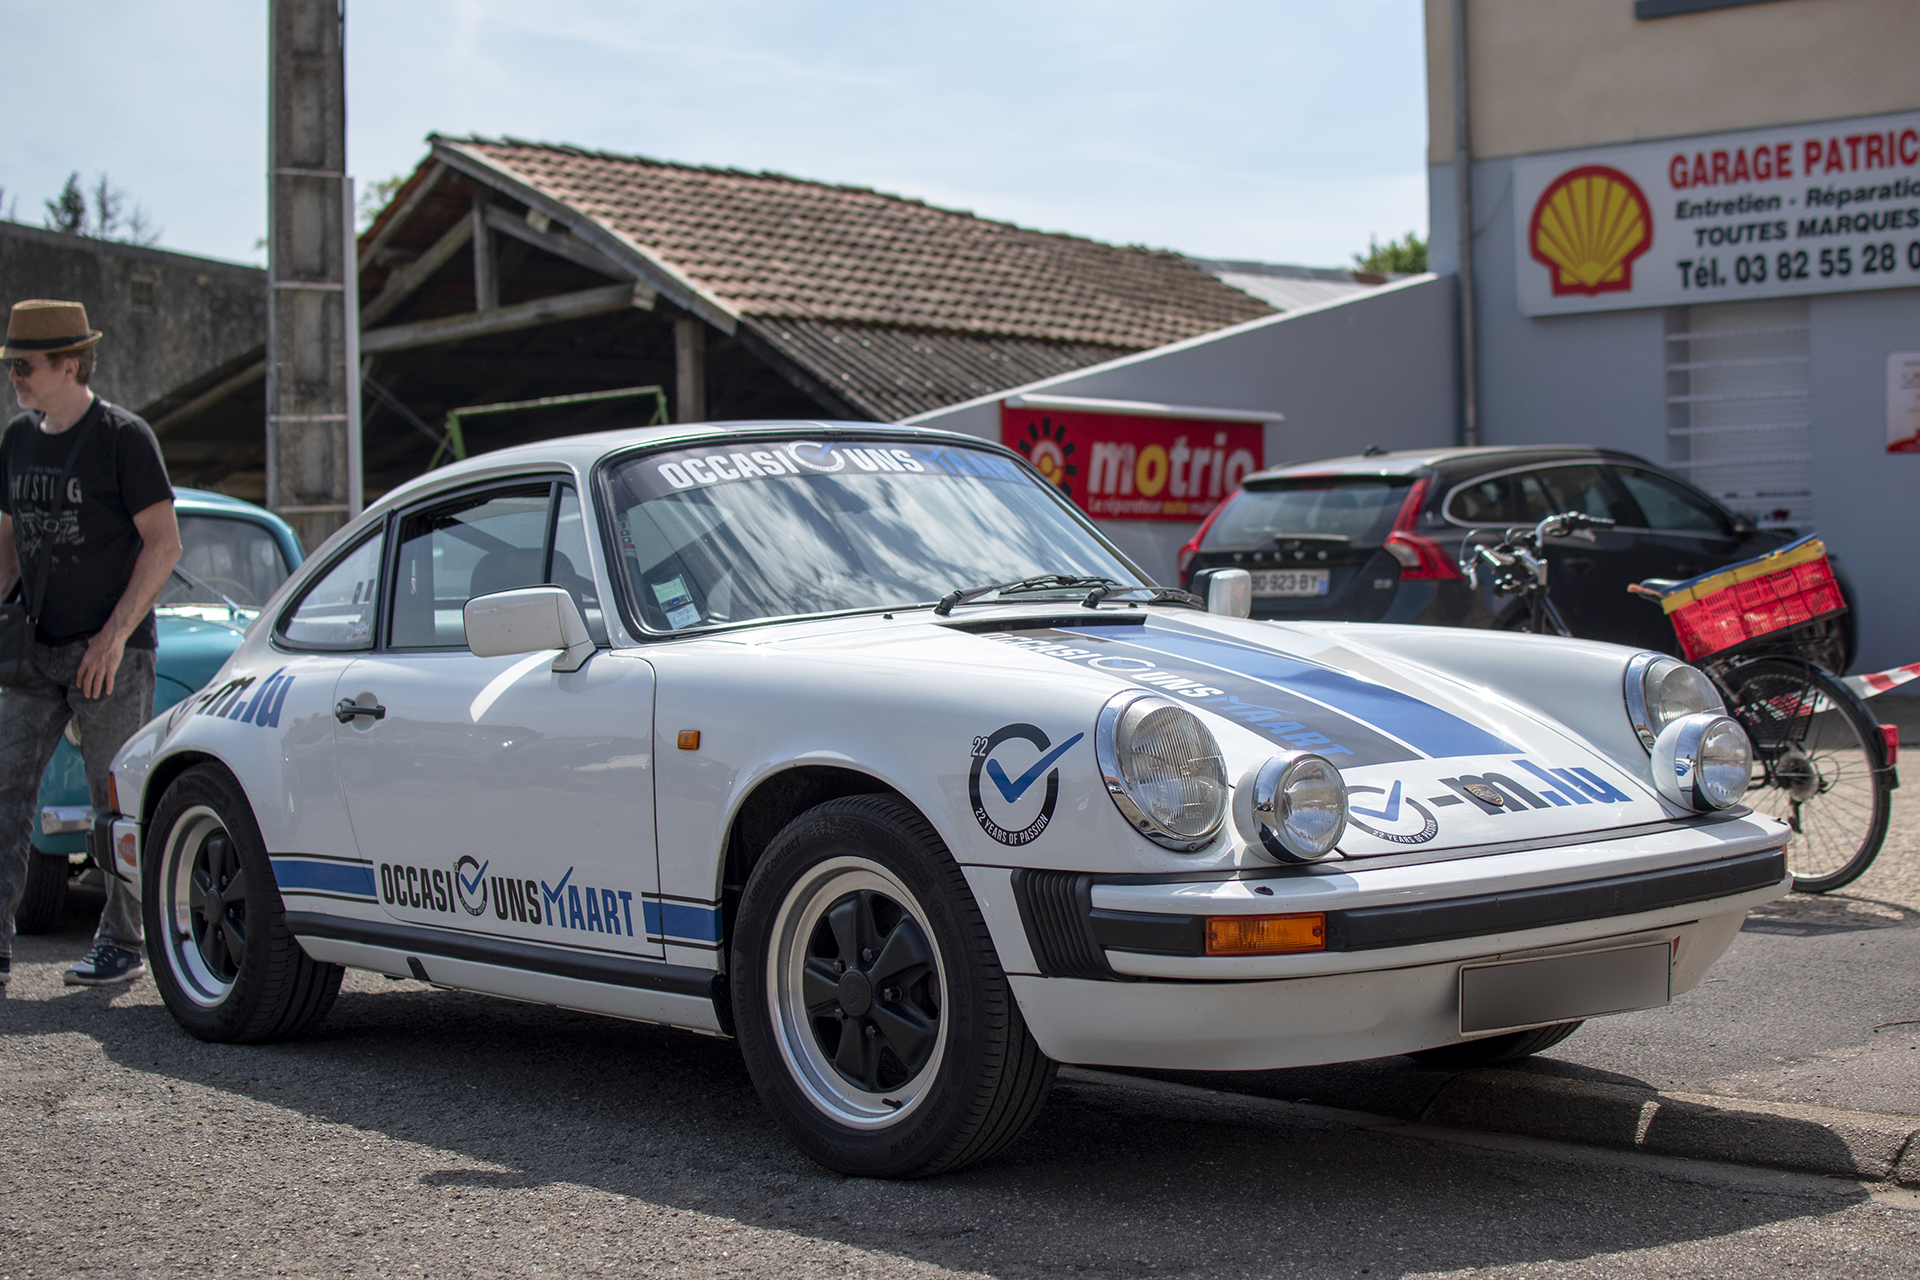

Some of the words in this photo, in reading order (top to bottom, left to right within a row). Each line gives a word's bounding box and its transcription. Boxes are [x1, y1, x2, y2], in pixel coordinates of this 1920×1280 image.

[1669, 142, 1793, 191] GARAGE
[1803, 128, 1920, 176] PATRIC
[1675, 192, 1782, 220] Entretien
[1695, 219, 1788, 247] TOUTES
[1796, 207, 1920, 239] MARQUES
[1677, 254, 1727, 290] Tél.
[1735, 253, 1767, 284] 03
[1777, 249, 1810, 281] 82
[1819, 246, 1852, 278] 55
[1862, 242, 1896, 274] 28
[1087, 431, 1256, 498] motrio
[971, 736, 989, 757] 22
[975, 807, 987, 822] 22
[984, 819, 1008, 843] YEARS
[1008, 833, 1019, 844] OF
[1019, 813, 1049, 844] PASSION
[1387, 833, 1415, 844] YEARS
